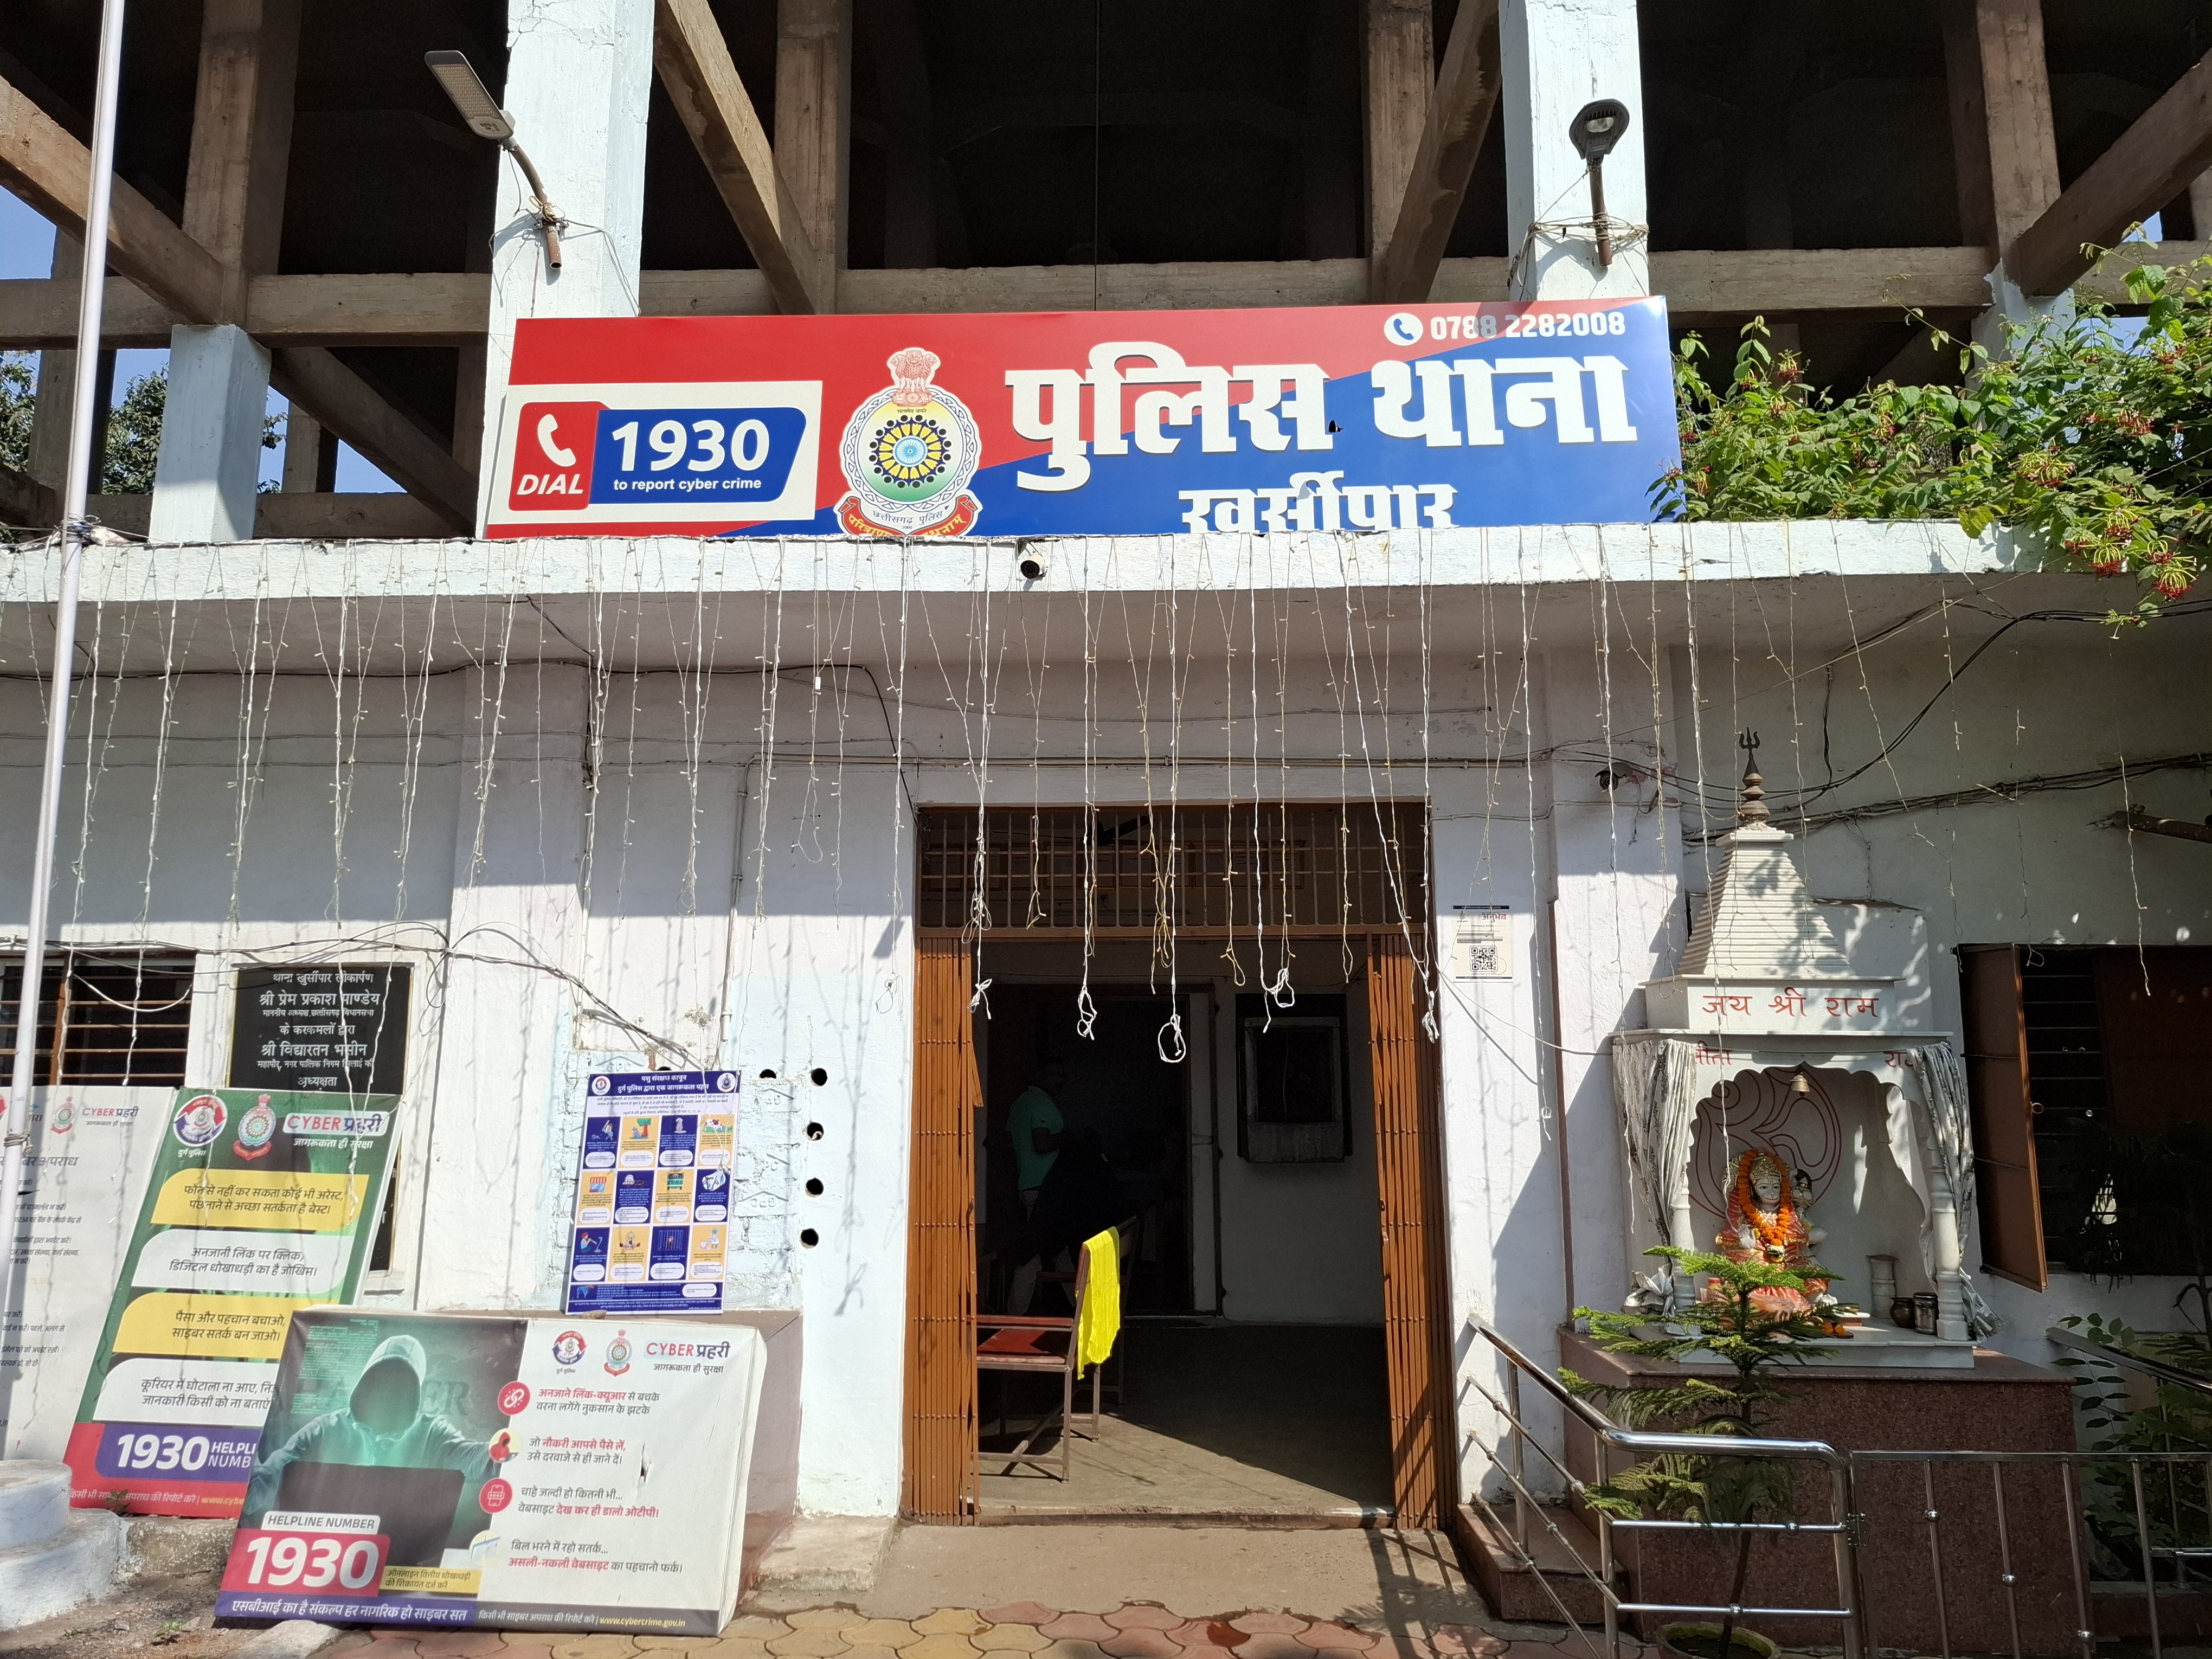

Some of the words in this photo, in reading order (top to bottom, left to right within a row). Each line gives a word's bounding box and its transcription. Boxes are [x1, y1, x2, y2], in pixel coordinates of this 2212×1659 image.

[1431, 316, 1497, 340] 0788
[1504, 312, 1626, 338] 2282008
[1005, 341, 1333, 492] पुलिस
[1371, 355, 1637, 447] थाना
[612, 419, 770, 472] 1930
[517, 474, 583, 496] DIAL
[614, 479, 628, 491] to
[632, 479, 675, 493] report
[678, 478, 719, 492] cyber
[723, 478, 762, 490] crime
[872, 510, 914, 525] छत्तीसगढ़
[918, 510, 943, 525] पुलिस
[259, 991, 275, 1006] श्री
[278, 989, 298, 1006] प्रेम
[300, 993, 337, 1006] प्रकाश
[342, 989, 381, 1006] पाण्डेय
[1702, 995, 1753, 1016] जय
[1769, 987, 1807, 1018] श्री
[1824, 997, 1880, 1018] राम
[279, 1023, 290, 1035] के
[293, 1022, 337, 1035] करकमलों
[338, 1025, 356, 1037] द्वारा
[261, 1041, 277, 1057] श्री
[280, 1041, 330, 1057] विद्यारतन
[298, 1077, 338, 1088] अध्यक्षता
[627, 1084, 642, 1094] पुलिस
[82, 1108, 114, 1117] CYBER
[115, 1106, 139, 1118] प्रहरी
[287, 1115, 342, 1131] CYBER
[293, 1138, 337, 1148] जागरूकता
[338, 1138, 348, 1148] ही
[38, 1156, 79, 1167] अपराध
[206, 1185, 216, 1194] से
[217, 1184, 235, 1197] नहीं
[235, 1188, 250, 1197] कर
[253, 1188, 281, 1198] सकता
[282, 1187, 303, 1200] कोई
[303, 1188, 314, 1199] भी
[191, 1246, 231, 1258] अनजानी
[232, 1246, 256, 1259] लिंक
[258, 1250, 272, 1261] पर
[169, 1258, 209, 1273] डिजिटल
[255, 1264, 271, 1274] का
[271, 1263, 280, 1276] है
[176, 1309, 196, 1323] पैसा
[197, 1310, 216, 1323] और
[217, 1314, 252, 1326] पहचान
[172, 1327, 206, 1341] साइबर
[207, 1327, 233, 1340] सतर्क
[234, 1330, 252, 1340] बन
[646, 1341, 694, 1357] CYBER
[696, 1341, 731, 1360] प्रहरी
[653, 1363, 691, 1372] जागरूकता
[693, 1363, 701, 1373] ही
[703, 1365, 724, 1375] सुरक्षा
[142, 1393, 185, 1407] जानकारी
[186, 1394, 214, 1408] किसी
[215, 1396, 229, 1408] को
[230, 1398, 243, 1409] ना
[538, 1388, 572, 1399] अनजाने
[628, 1392, 636, 1402] से
[637, 1392, 660, 1403] बचके
[537, 1402, 557, 1412] वरना
[582, 1404, 615, 1416] नुकसान
[616, 1403, 626, 1414] के
[627, 1405, 650, 1416] झटके
[211, 1442, 257, 1455] HELPLI
[530, 1436, 541, 1447] जो
[542, 1436, 570, 1450] नौकरी
[571, 1439, 597, 1450] आपसे
[599, 1438, 613, 1451] पैसे
[117, 1434, 210, 1470] 1930
[527, 1451, 541, 1462] उसे
[542, 1451, 572, 1463] दरवाजे
[573, 1452, 581, 1464] से
[582, 1452, 593, 1465] ही
[594, 1454, 611, 1464] जाने
[208, 1455, 251, 1468] NUMB
[520, 1486, 538, 1498] चाहे
[539, 1486, 563, 1499] जल्दी
[564, 1487, 574, 1500] हो
[575, 1487, 605, 1500] कितनी
[518, 1503, 556, 1515] वेबसाइट
[556, 1503, 573, 1515] देख
[574, 1506, 590, 1516] कर
[591, 1505, 601, 1516] ही
[602, 1506, 625, 1517] डालो
[267, 1514, 325, 1528] HELPLINE
[325, 1517, 375, 1530] NUMBER
[511, 1540, 530, 1552] बिल
[532, 1541, 552, 1552] भरने
[552, 1541, 561, 1553] में
[562, 1542, 576, 1554] रहो
[247, 1536, 379, 1590] 1930
[571, 1558, 610, 1572] वेबसाइट
[611, 1561, 624, 1571] का
[625, 1561, 659, 1573] पहचानो
[232, 1598, 283, 1616] एसबीआई
[283, 1603, 299, 1614] का
[299, 1600, 308, 1616] है
[309, 1601, 344, 1616] संकल्प
[344, 1605, 359, 1618] हर
[361, 1604, 399, 1618] नागरिक
[401, 1604, 414, 1620] हो
[414, 1607, 448, 1622] साइबर
[478, 1609, 497, 1620] किसी
[498, 1610, 506, 1620] भी
[507, 1612, 529, 1622] साइबर
[530, 1613, 553, 1622] अपराध
[555, 1612, 564, 1623] की
[565, 1612, 583, 1623] रिपोर्ट
[600, 1617, 685, 1628] www.cybercrime.gov.in
